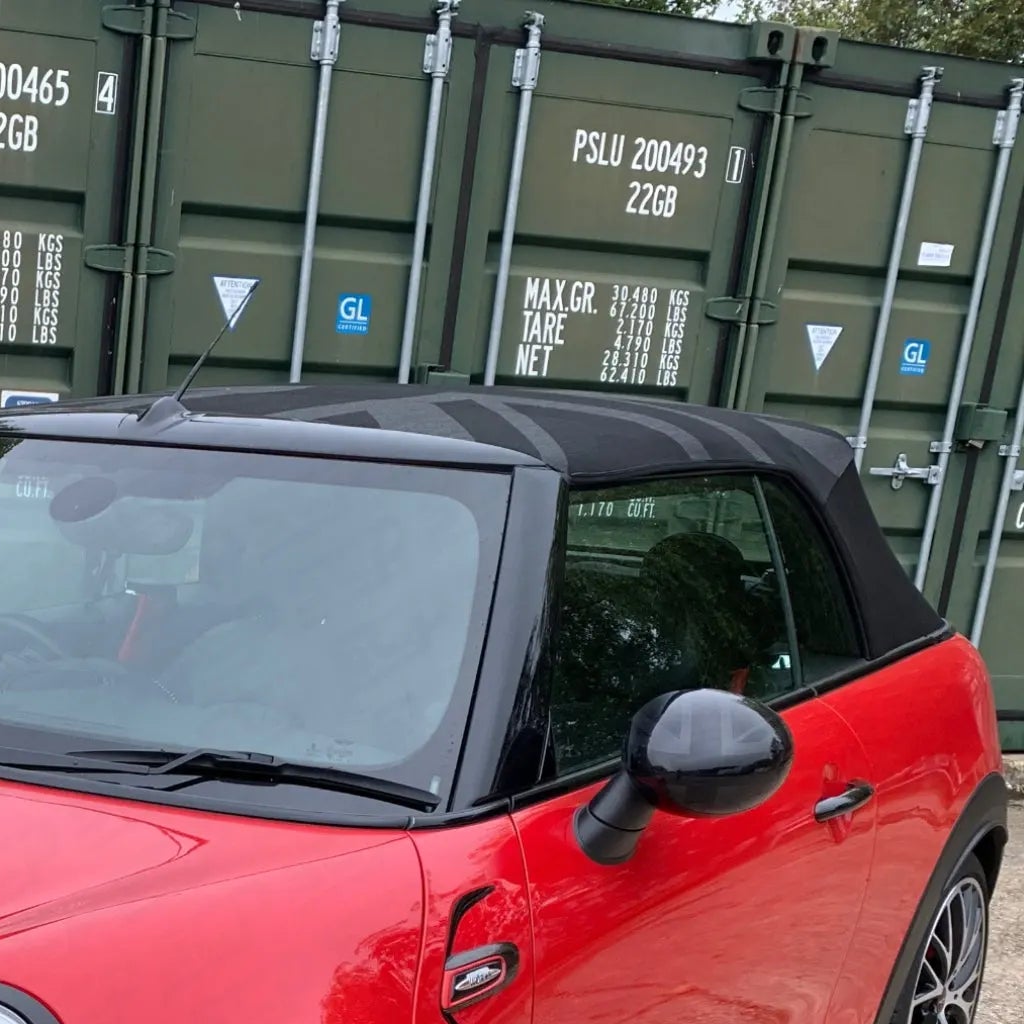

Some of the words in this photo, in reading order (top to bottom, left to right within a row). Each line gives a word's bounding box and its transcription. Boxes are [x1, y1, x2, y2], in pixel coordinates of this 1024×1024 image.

[98, 75, 113, 111] 4
[572, 129, 625, 167] PSLU
[631, 137, 708, 178] 200493
[625, 181, 678, 218] 22GB
[38, 233, 63, 253] KGS
[37, 251, 62, 271] LBS
[36, 270, 61, 290] KGS
[35, 288, 59, 308] LBS
[523, 277, 598, 315] MAX.GR.
[668, 289, 689, 306] KGS
[33, 306, 58, 326] KGS
[340, 296, 368, 320] GL
[666, 305, 687, 323] LBS
[32, 325, 57, 344] LBS
[522, 310, 567, 345] TARE
[664, 321, 685, 339] KGS
[661, 337, 682, 355] LBS
[904, 342, 927, 364] GL
[515, 343, 553, 376] NET
[659, 353, 680, 371] KGS
[656, 369, 677, 387] LBS
